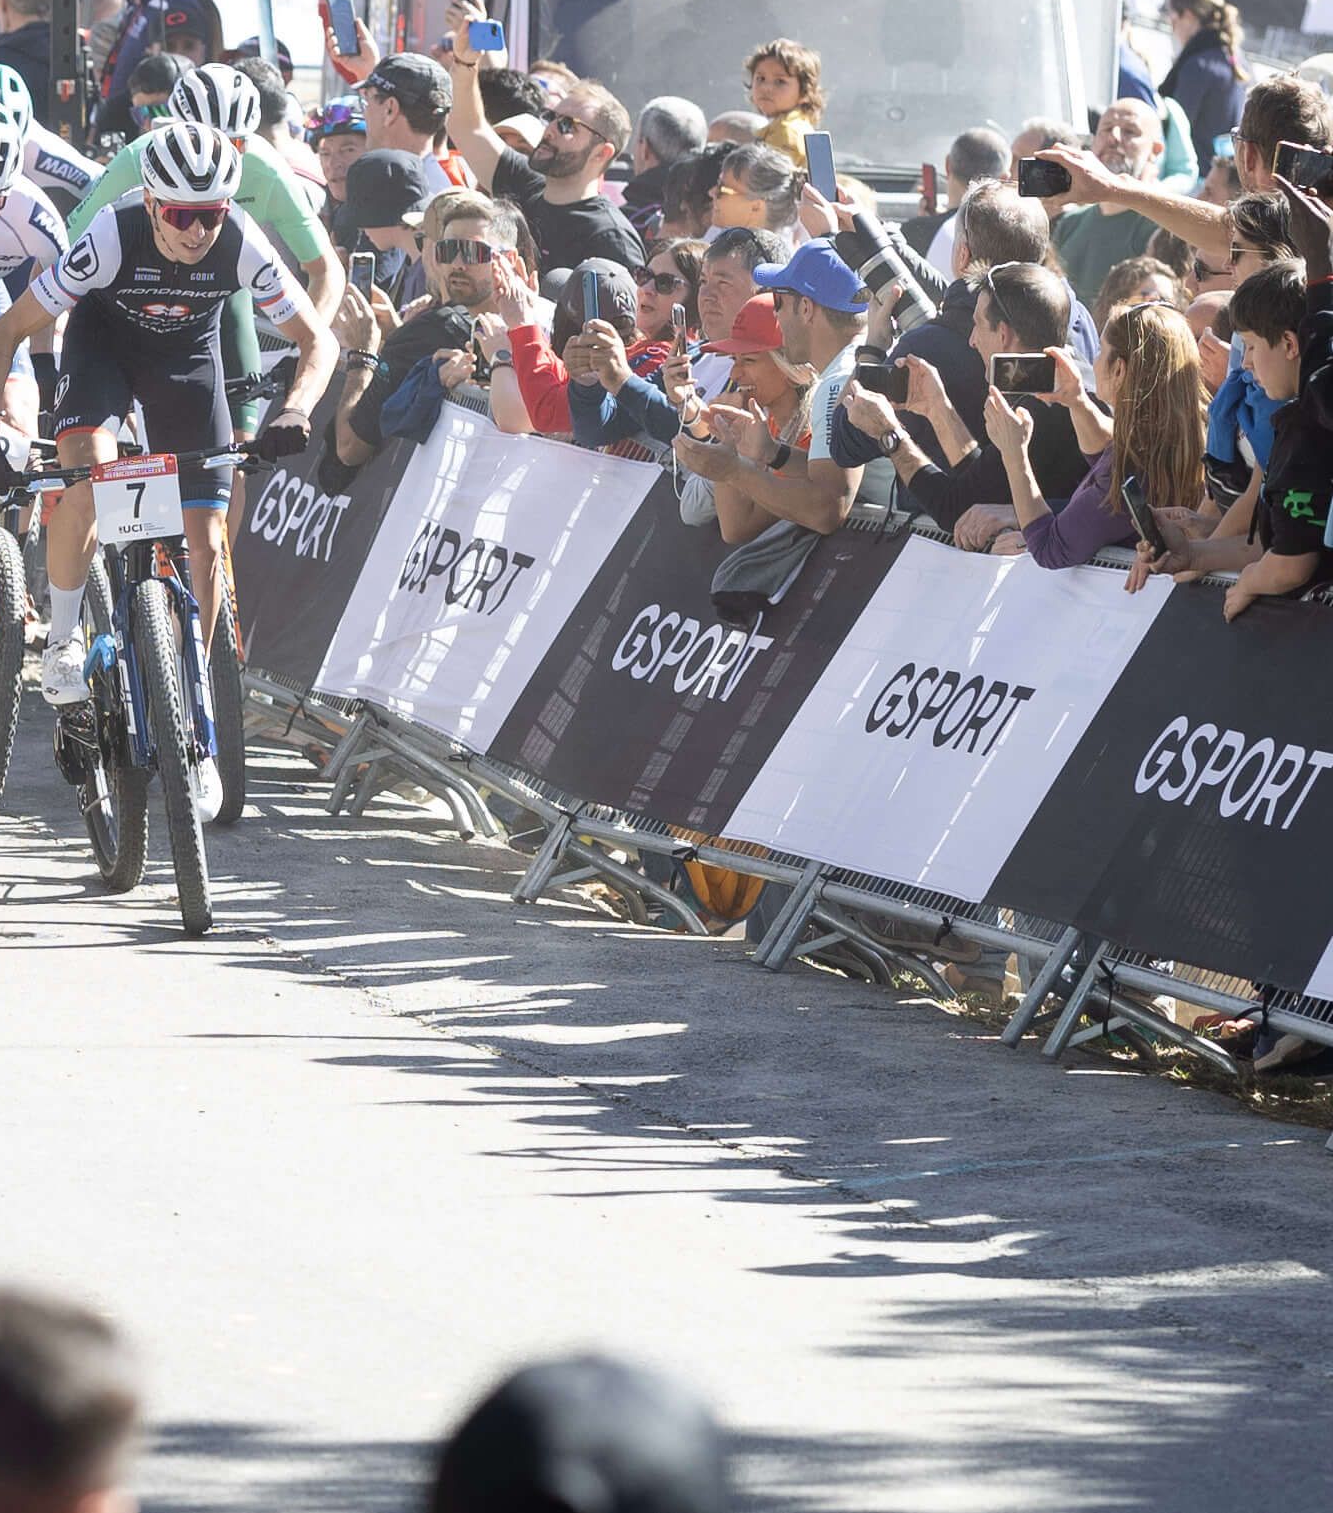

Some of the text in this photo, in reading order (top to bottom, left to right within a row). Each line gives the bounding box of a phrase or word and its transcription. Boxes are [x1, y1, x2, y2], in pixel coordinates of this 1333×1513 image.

[126, 482, 146, 519] 7
[251, 468, 351, 564] GSPORT
[398, 520, 536, 616] GSPORT
[611, 603, 774, 703] GSPORT
[865, 662, 1037, 757] GSPORT
[1133, 715, 1333, 831] GSPORT
